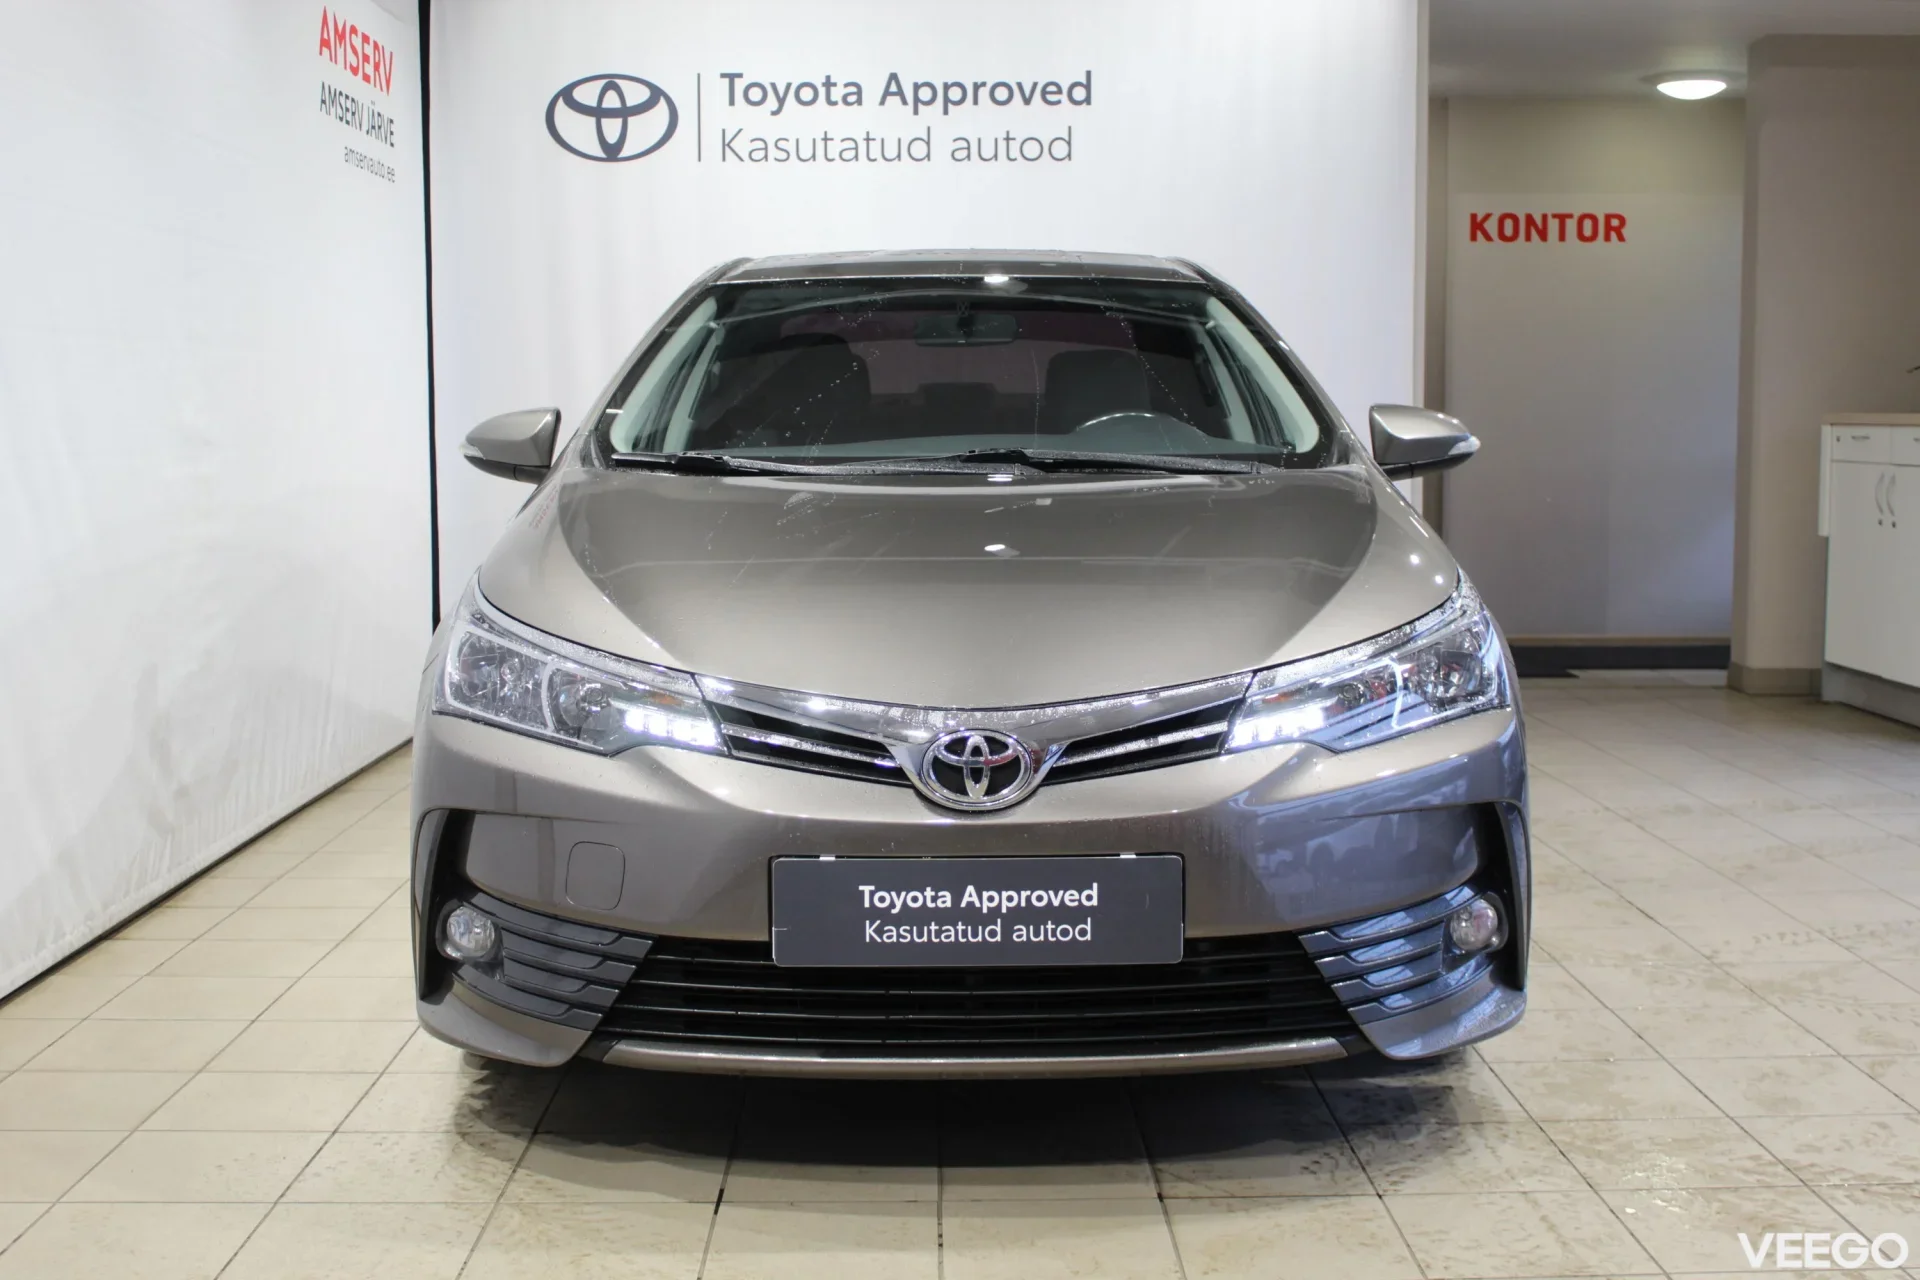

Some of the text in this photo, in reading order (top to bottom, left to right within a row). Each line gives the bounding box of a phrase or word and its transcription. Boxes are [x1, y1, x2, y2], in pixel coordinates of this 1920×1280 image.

[319, 5, 393, 96] AMSERV
[720, 70, 1093, 116] Toyota Approved
[320, 81, 395, 148] AMSERV JÄRVE
[721, 125, 1073, 162] Kasutatud autod
[344, 146, 396, 183] amservauto.ee
[1469, 212, 1627, 243] KONTOR
[859, 882, 1099, 914] Toyota Approved
[864, 917, 1092, 943] Kasutatud autod
